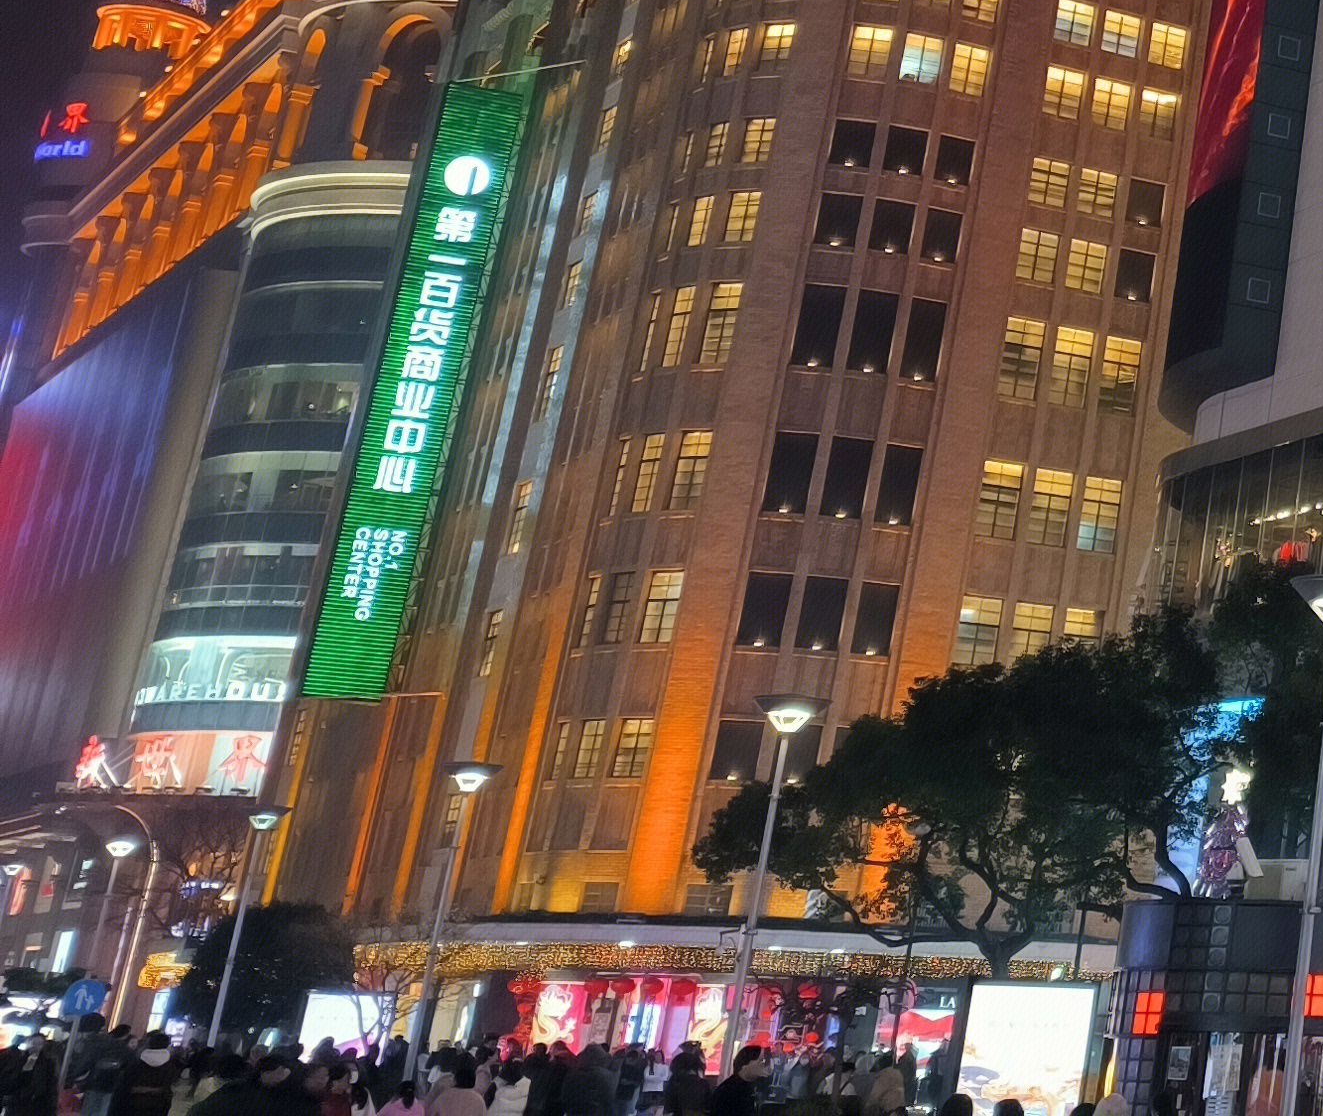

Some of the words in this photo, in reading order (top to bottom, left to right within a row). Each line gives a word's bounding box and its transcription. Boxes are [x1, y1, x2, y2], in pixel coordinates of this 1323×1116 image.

[372, 206, 477, 494] 第一百货商业中心
[340, 527, 372, 598] CENTER
[354, 527, 389, 621] SHOPPING
